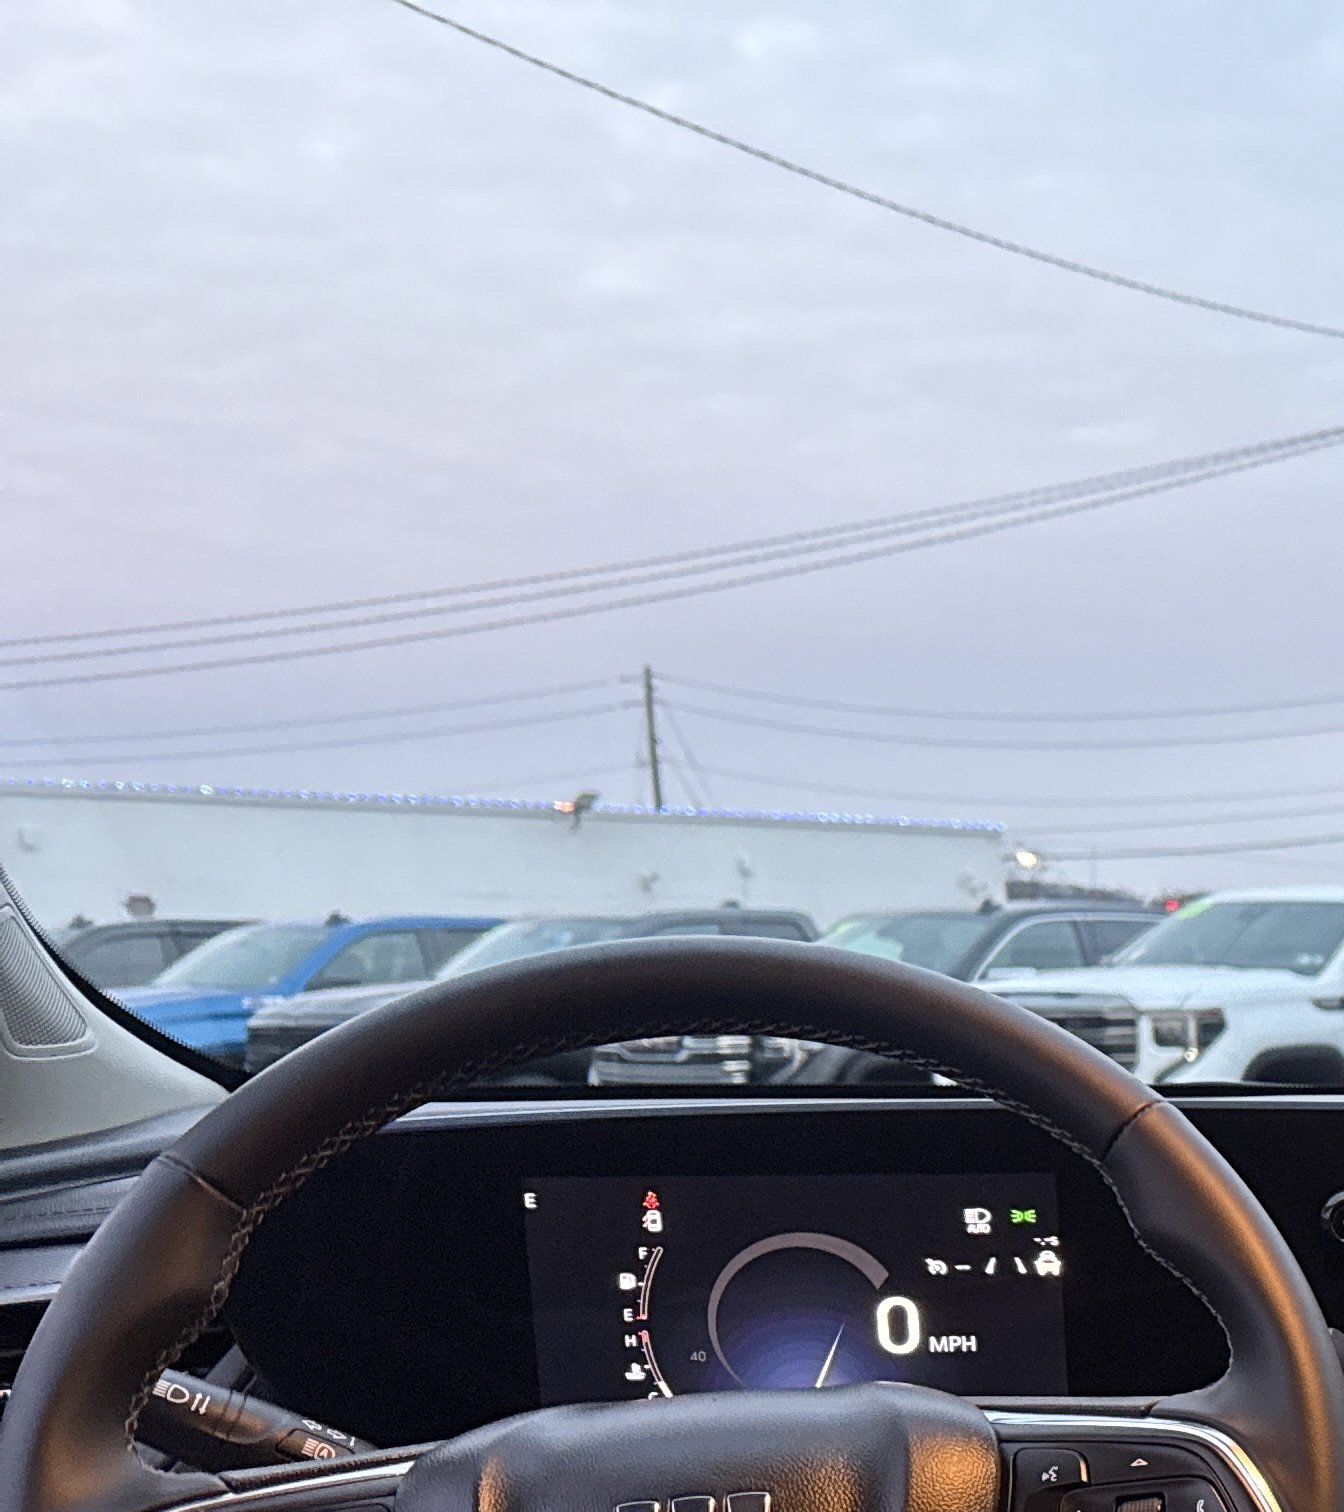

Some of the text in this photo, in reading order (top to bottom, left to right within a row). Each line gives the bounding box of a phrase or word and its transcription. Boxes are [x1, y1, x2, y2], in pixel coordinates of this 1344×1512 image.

[524, 1193, 537, 1209] E
[638, 1246, 648, 1260] F
[623, 1308, 634, 1322] E
[876, 1295, 978, 1355] 0 MPH
[624, 1334, 638, 1347] H
[689, 1350, 707, 1362] 40
